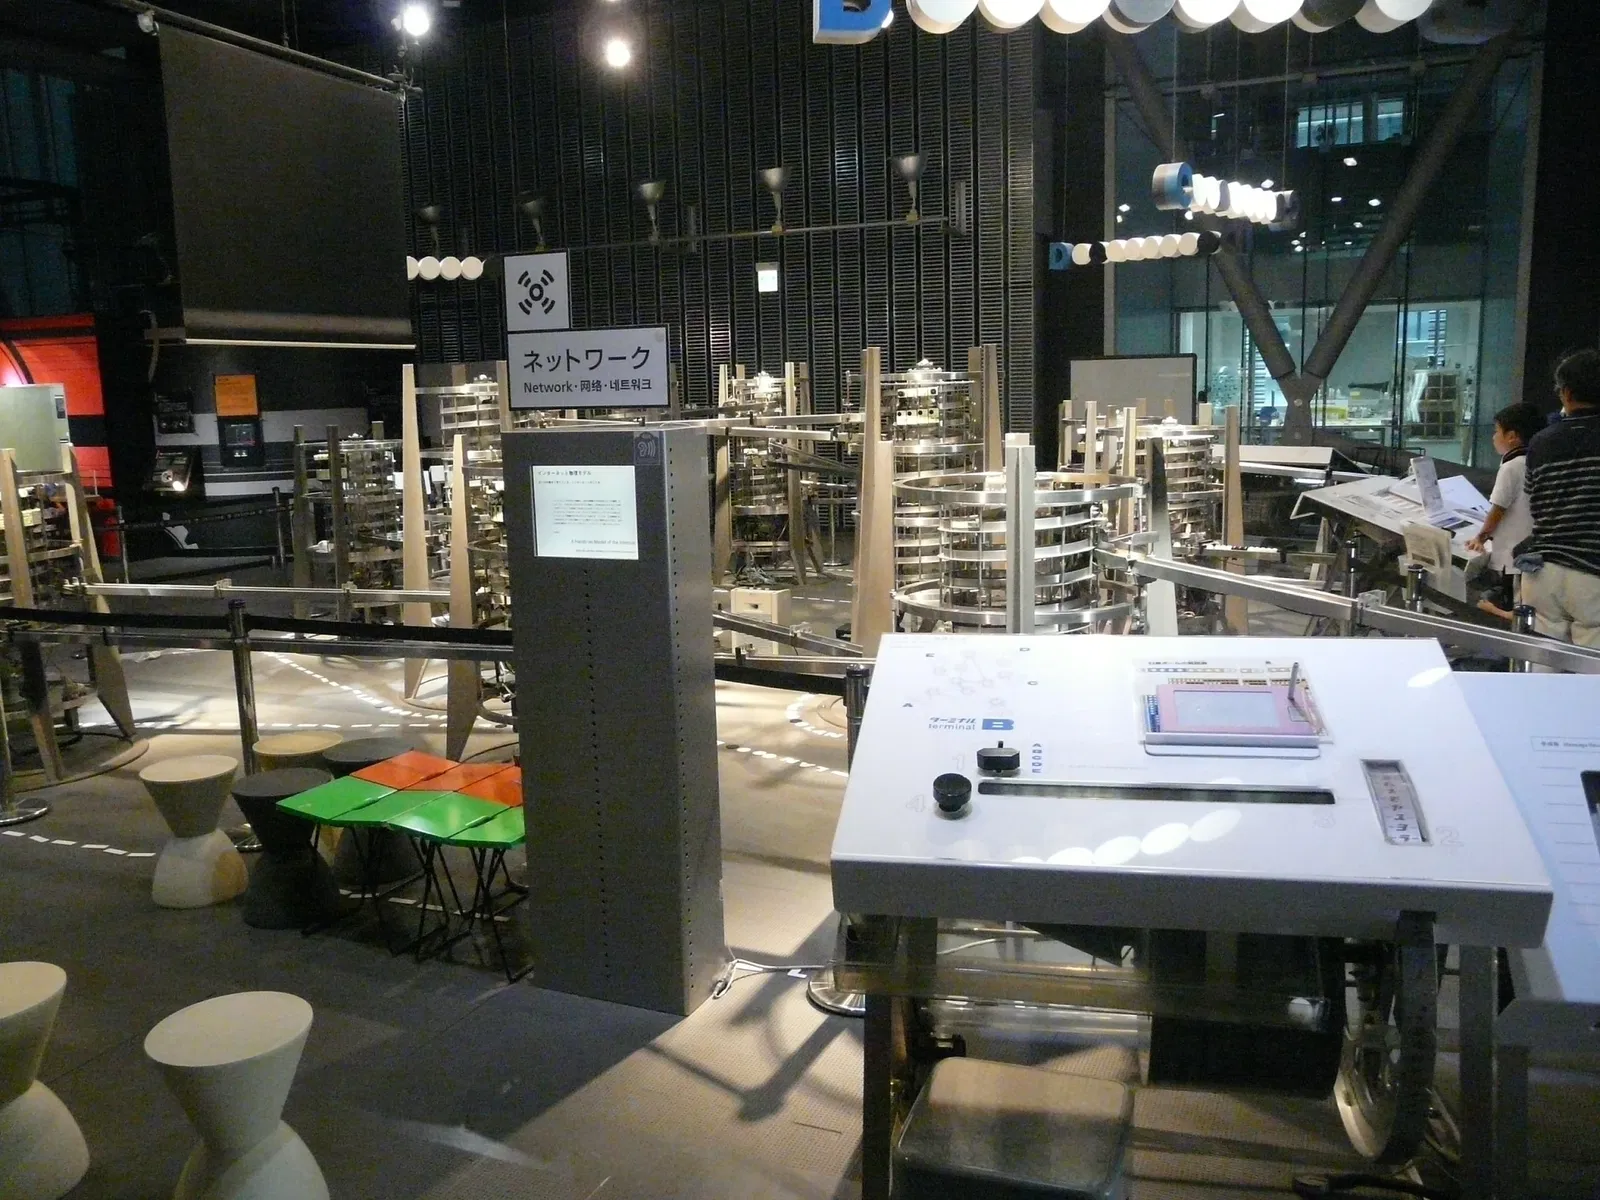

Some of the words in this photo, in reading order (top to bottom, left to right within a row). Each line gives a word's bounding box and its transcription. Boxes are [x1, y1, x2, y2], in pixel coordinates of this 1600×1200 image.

[523, 346, 650, 373] ネットワーク
[523, 381, 573, 393] Network
[580, 380, 602, 392] 网络
[609, 378, 652, 391] 네트워크
[928, 723, 976, 731] terminal
[981, 718, 1015, 731] B
